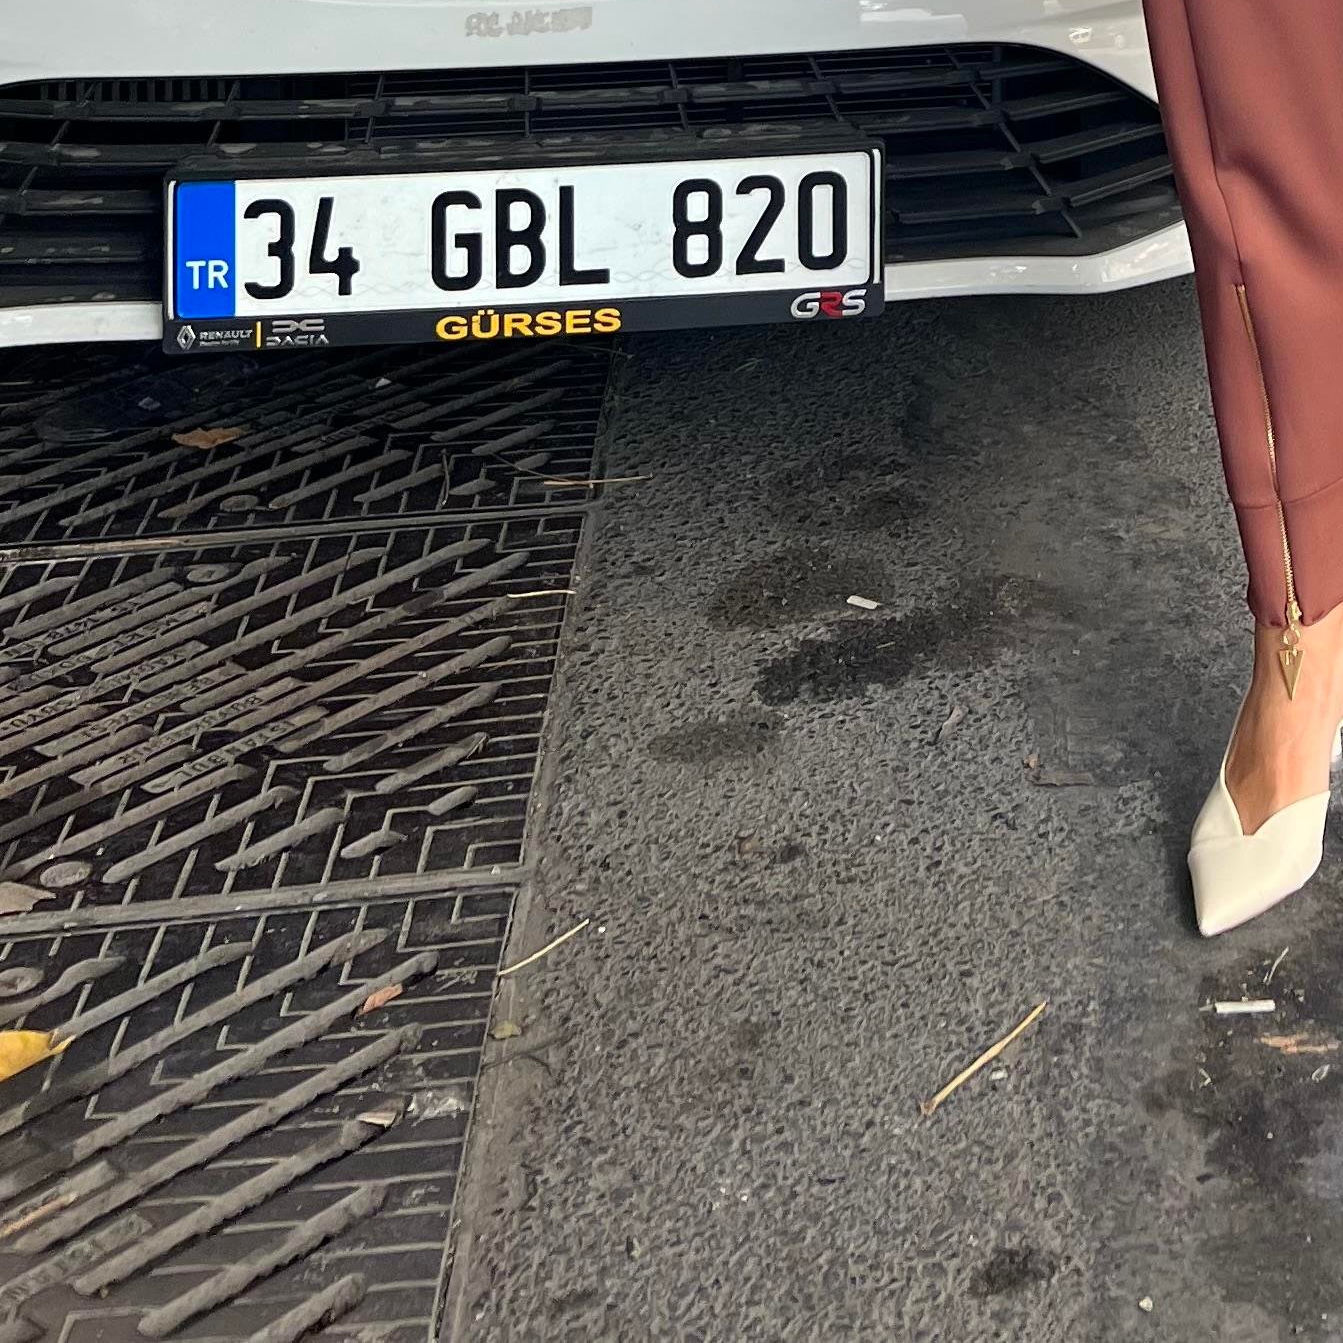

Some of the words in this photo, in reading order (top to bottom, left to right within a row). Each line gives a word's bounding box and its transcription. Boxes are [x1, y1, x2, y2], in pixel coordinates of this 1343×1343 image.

[243, 196, 361, 300] 34
[431, 184, 611, 292] GBL
[672, 170, 848, 279] 820
[185, 259, 230, 290] TR
[789, 288, 867, 319] GRS
[199, 329, 254, 340] RENAULT
[434, 307, 623, 341] GÜRSES
[265, 334, 330, 347] DACIA
